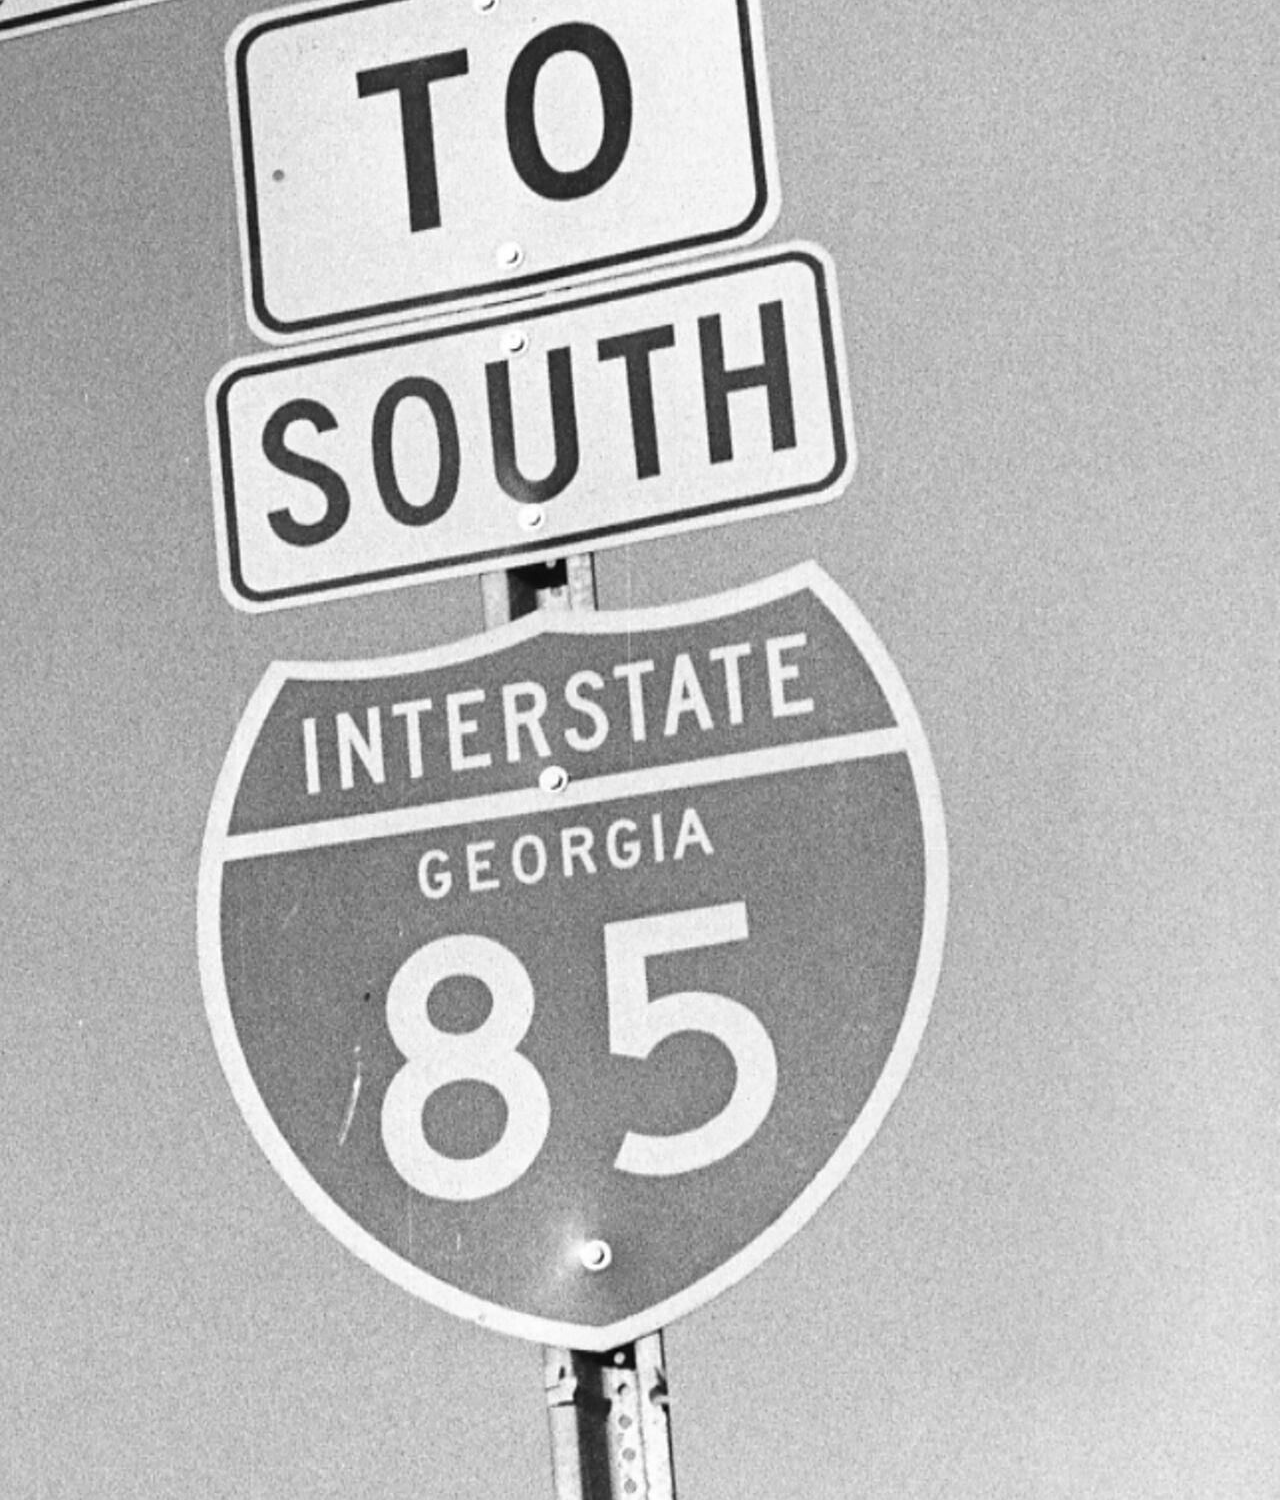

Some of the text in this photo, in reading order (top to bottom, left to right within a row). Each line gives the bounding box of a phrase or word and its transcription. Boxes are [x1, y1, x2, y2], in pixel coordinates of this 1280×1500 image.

[356, 21, 633, 233] TO
[261, 300, 797, 547] SOUTH
[301, 632, 816, 795] INTERSTATE
[417, 808, 715, 899] GEORGIA
[380, 901, 778, 1202] 85
